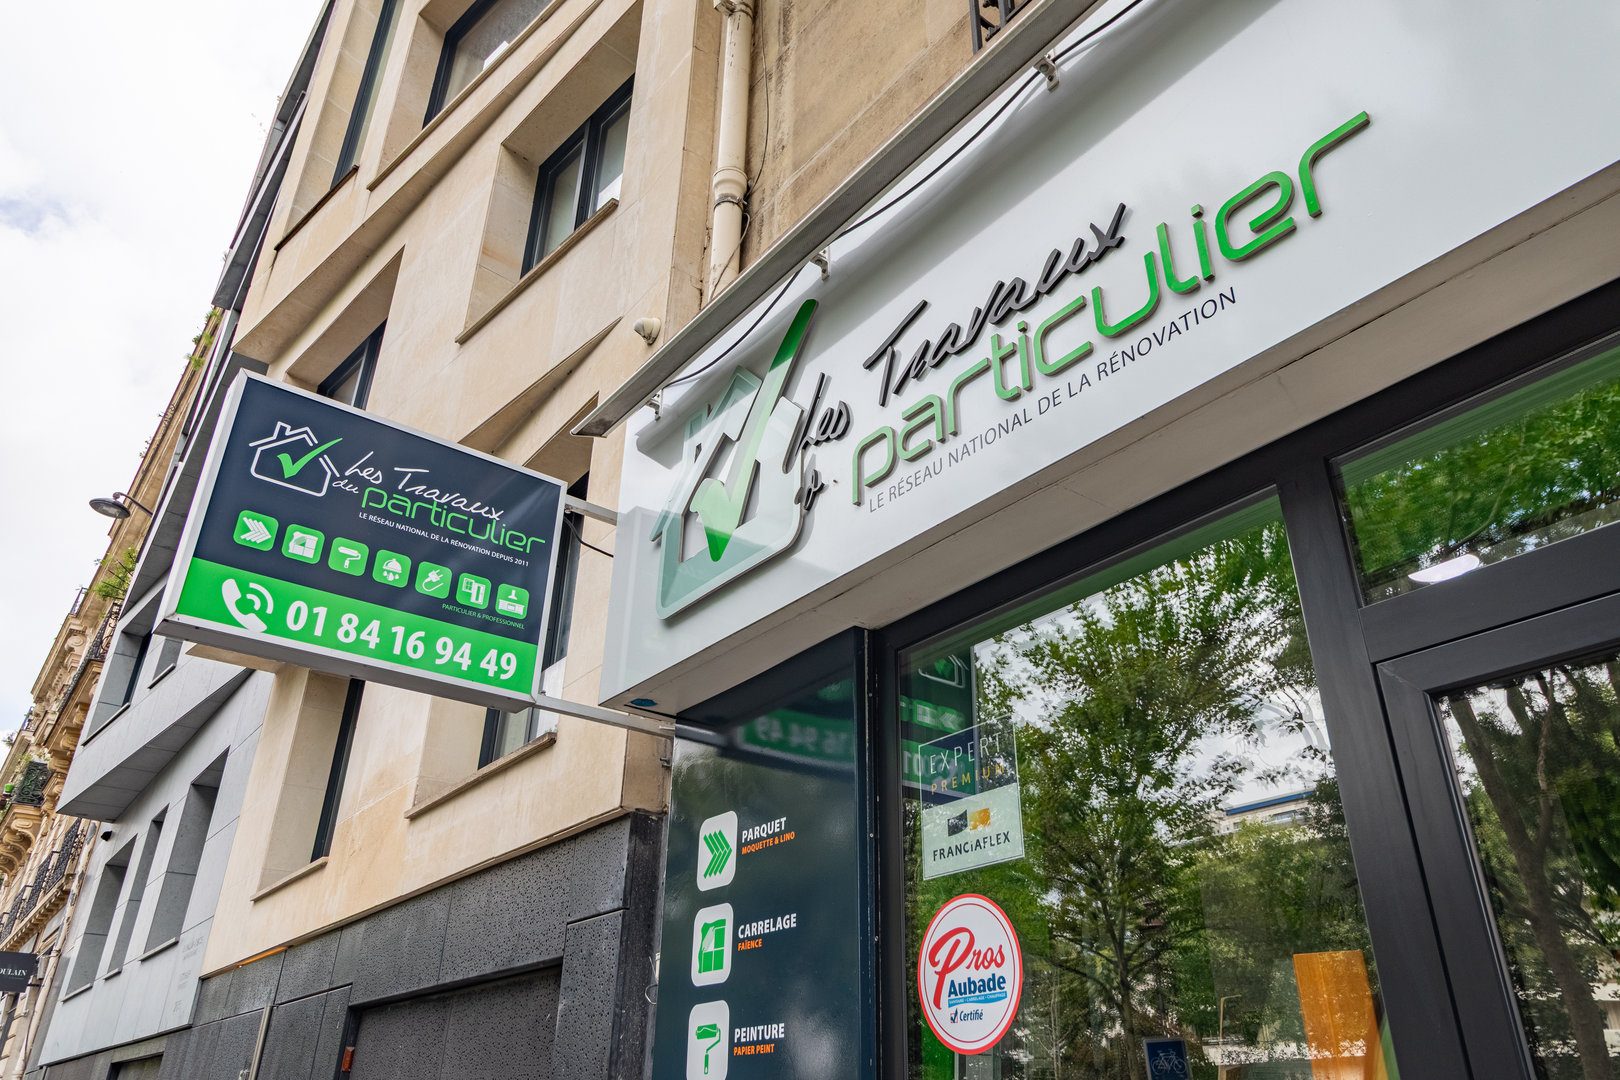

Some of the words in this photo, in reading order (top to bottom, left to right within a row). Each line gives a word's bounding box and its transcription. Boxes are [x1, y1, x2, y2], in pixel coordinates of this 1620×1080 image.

[852, 110, 1370, 506] particulier
[862, 202, 1126, 407] Travaux
[869, 492, 888, 513] LE
[889, 459, 943, 502] RÉSEAU
[948, 408, 1033, 467] NATIONAL
[1037, 389, 1062, 417] DE
[1068, 373, 1092, 399] LA
[1096, 286, 1237, 382] RÉNOVATION
[345, 451, 382, 484] Les
[394, 466, 505, 521] Travaux
[332, 478, 359, 494] du
[361, 486, 546, 554] particulier
[358, 512, 368, 520] LE
[368, 512, 395, 528] RÉSEAU
[395, 524, 429, 538] NATIONAL
[430, 533, 440, 542] DE
[441, 536, 450, 544] LA
[450, 537, 491, 556] RÉNOVATION
[491, 550, 514, 563] DEPUIS
[514, 557, 529, 567] 2011
[442, 603, 477, 618] PARTICULIER
[482, 613, 525, 630] PROFESSIONNEL
[285, 599, 328, 638] 01
[336, 612, 381, 650] 84
[390, 625, 426, 661] 16
[434, 636, 472, 672] 94
[478, 647, 518, 681] 49
[930, 732, 1002, 775] EXPERT
[931, 762, 1005, 796] PREMIUM
[741, 816, 787, 843] PARQUET
[741, 836, 774, 855] MOQUETTE
[774, 836, 780, 845] &
[780, 831, 796, 843] LINO
[738, 913, 797, 939] CARRELAGE
[737, 938, 763, 952] FAÏENCE
[928, 927, 1006, 1010] Pros
[948, 973, 1007, 998] Aubade
[959, 1008, 983, 1022] Certifié
[733, 1045, 755, 1056] PAPIER
[756, 1043, 775, 1054] PEINT
[734, 1022, 785, 1043] PEINTURE
